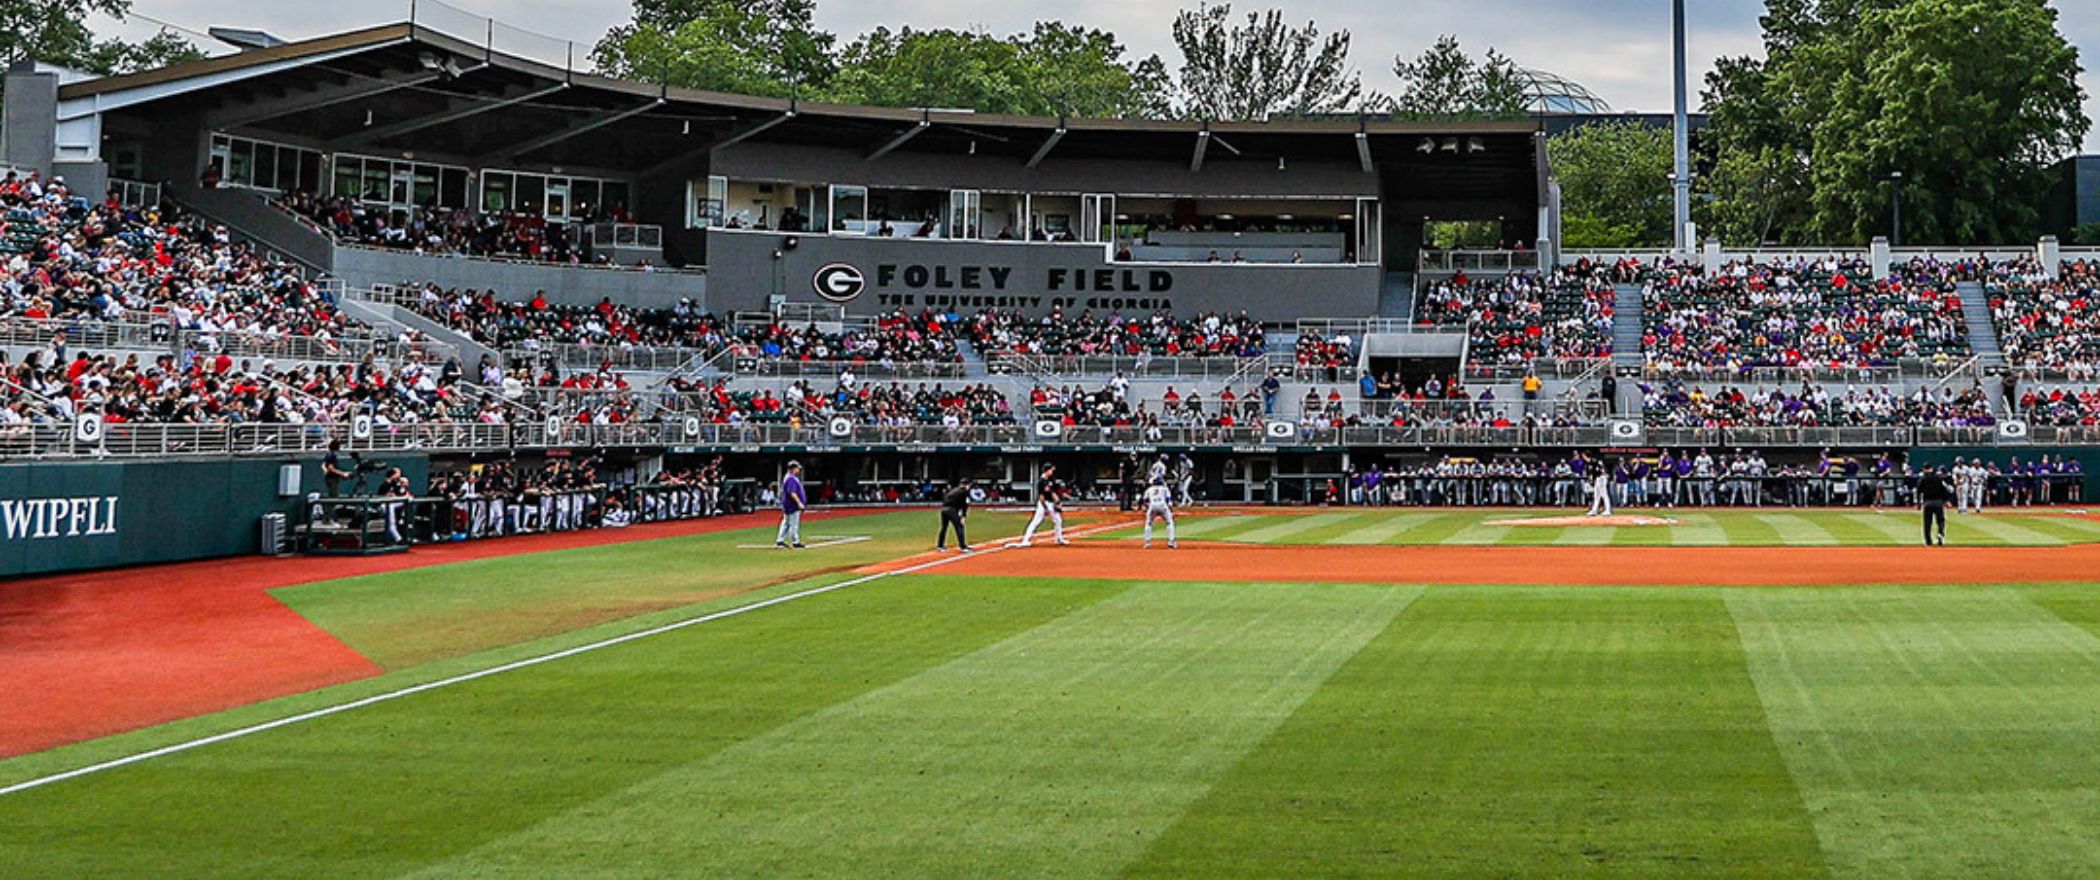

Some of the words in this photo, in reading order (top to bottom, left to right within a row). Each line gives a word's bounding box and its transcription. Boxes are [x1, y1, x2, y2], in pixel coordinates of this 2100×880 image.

[878, 264, 1011, 289] FOLEY
[1048, 268, 1173, 291] FIELD
[879, 294, 914, 305] THE
[925, 294, 1041, 308] UNIVERSITY
[1052, 298, 1075, 308] OF
[1087, 298, 1172, 309] GEORGIA
[83, 419, 96, 436] G
[358, 420, 367, 433] G
[0, 496, 119, 539] WIPFLI
